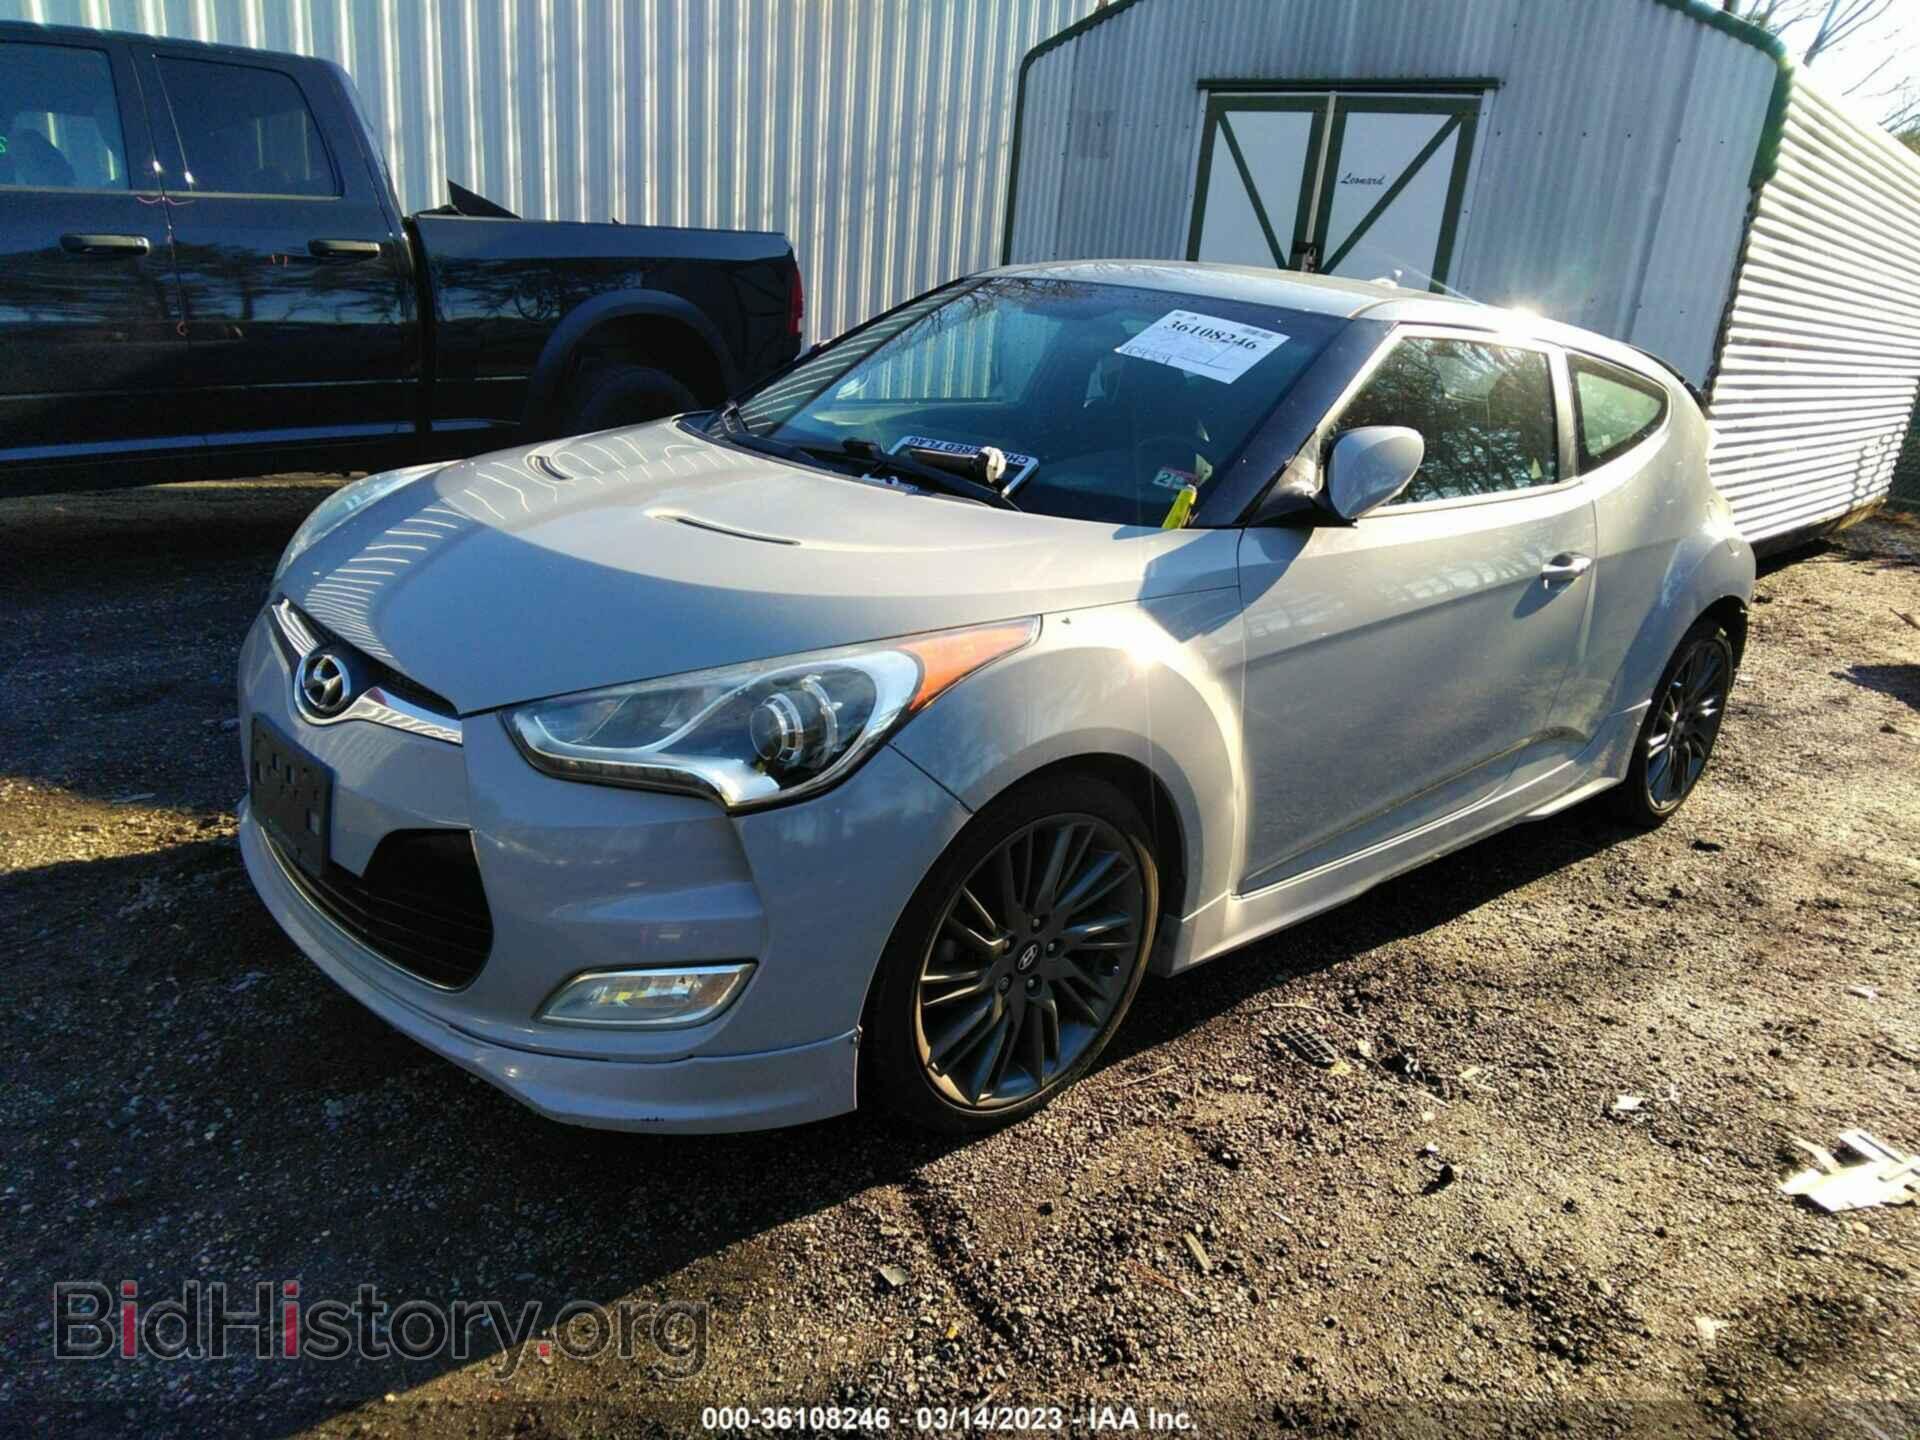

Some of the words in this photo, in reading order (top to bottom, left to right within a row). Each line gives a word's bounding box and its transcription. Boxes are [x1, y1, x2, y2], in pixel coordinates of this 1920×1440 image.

[1339, 172, 1387, 186] Leonard
[1163, 320, 1257, 350] 36108246
[908, 436, 943, 449] FLAG
